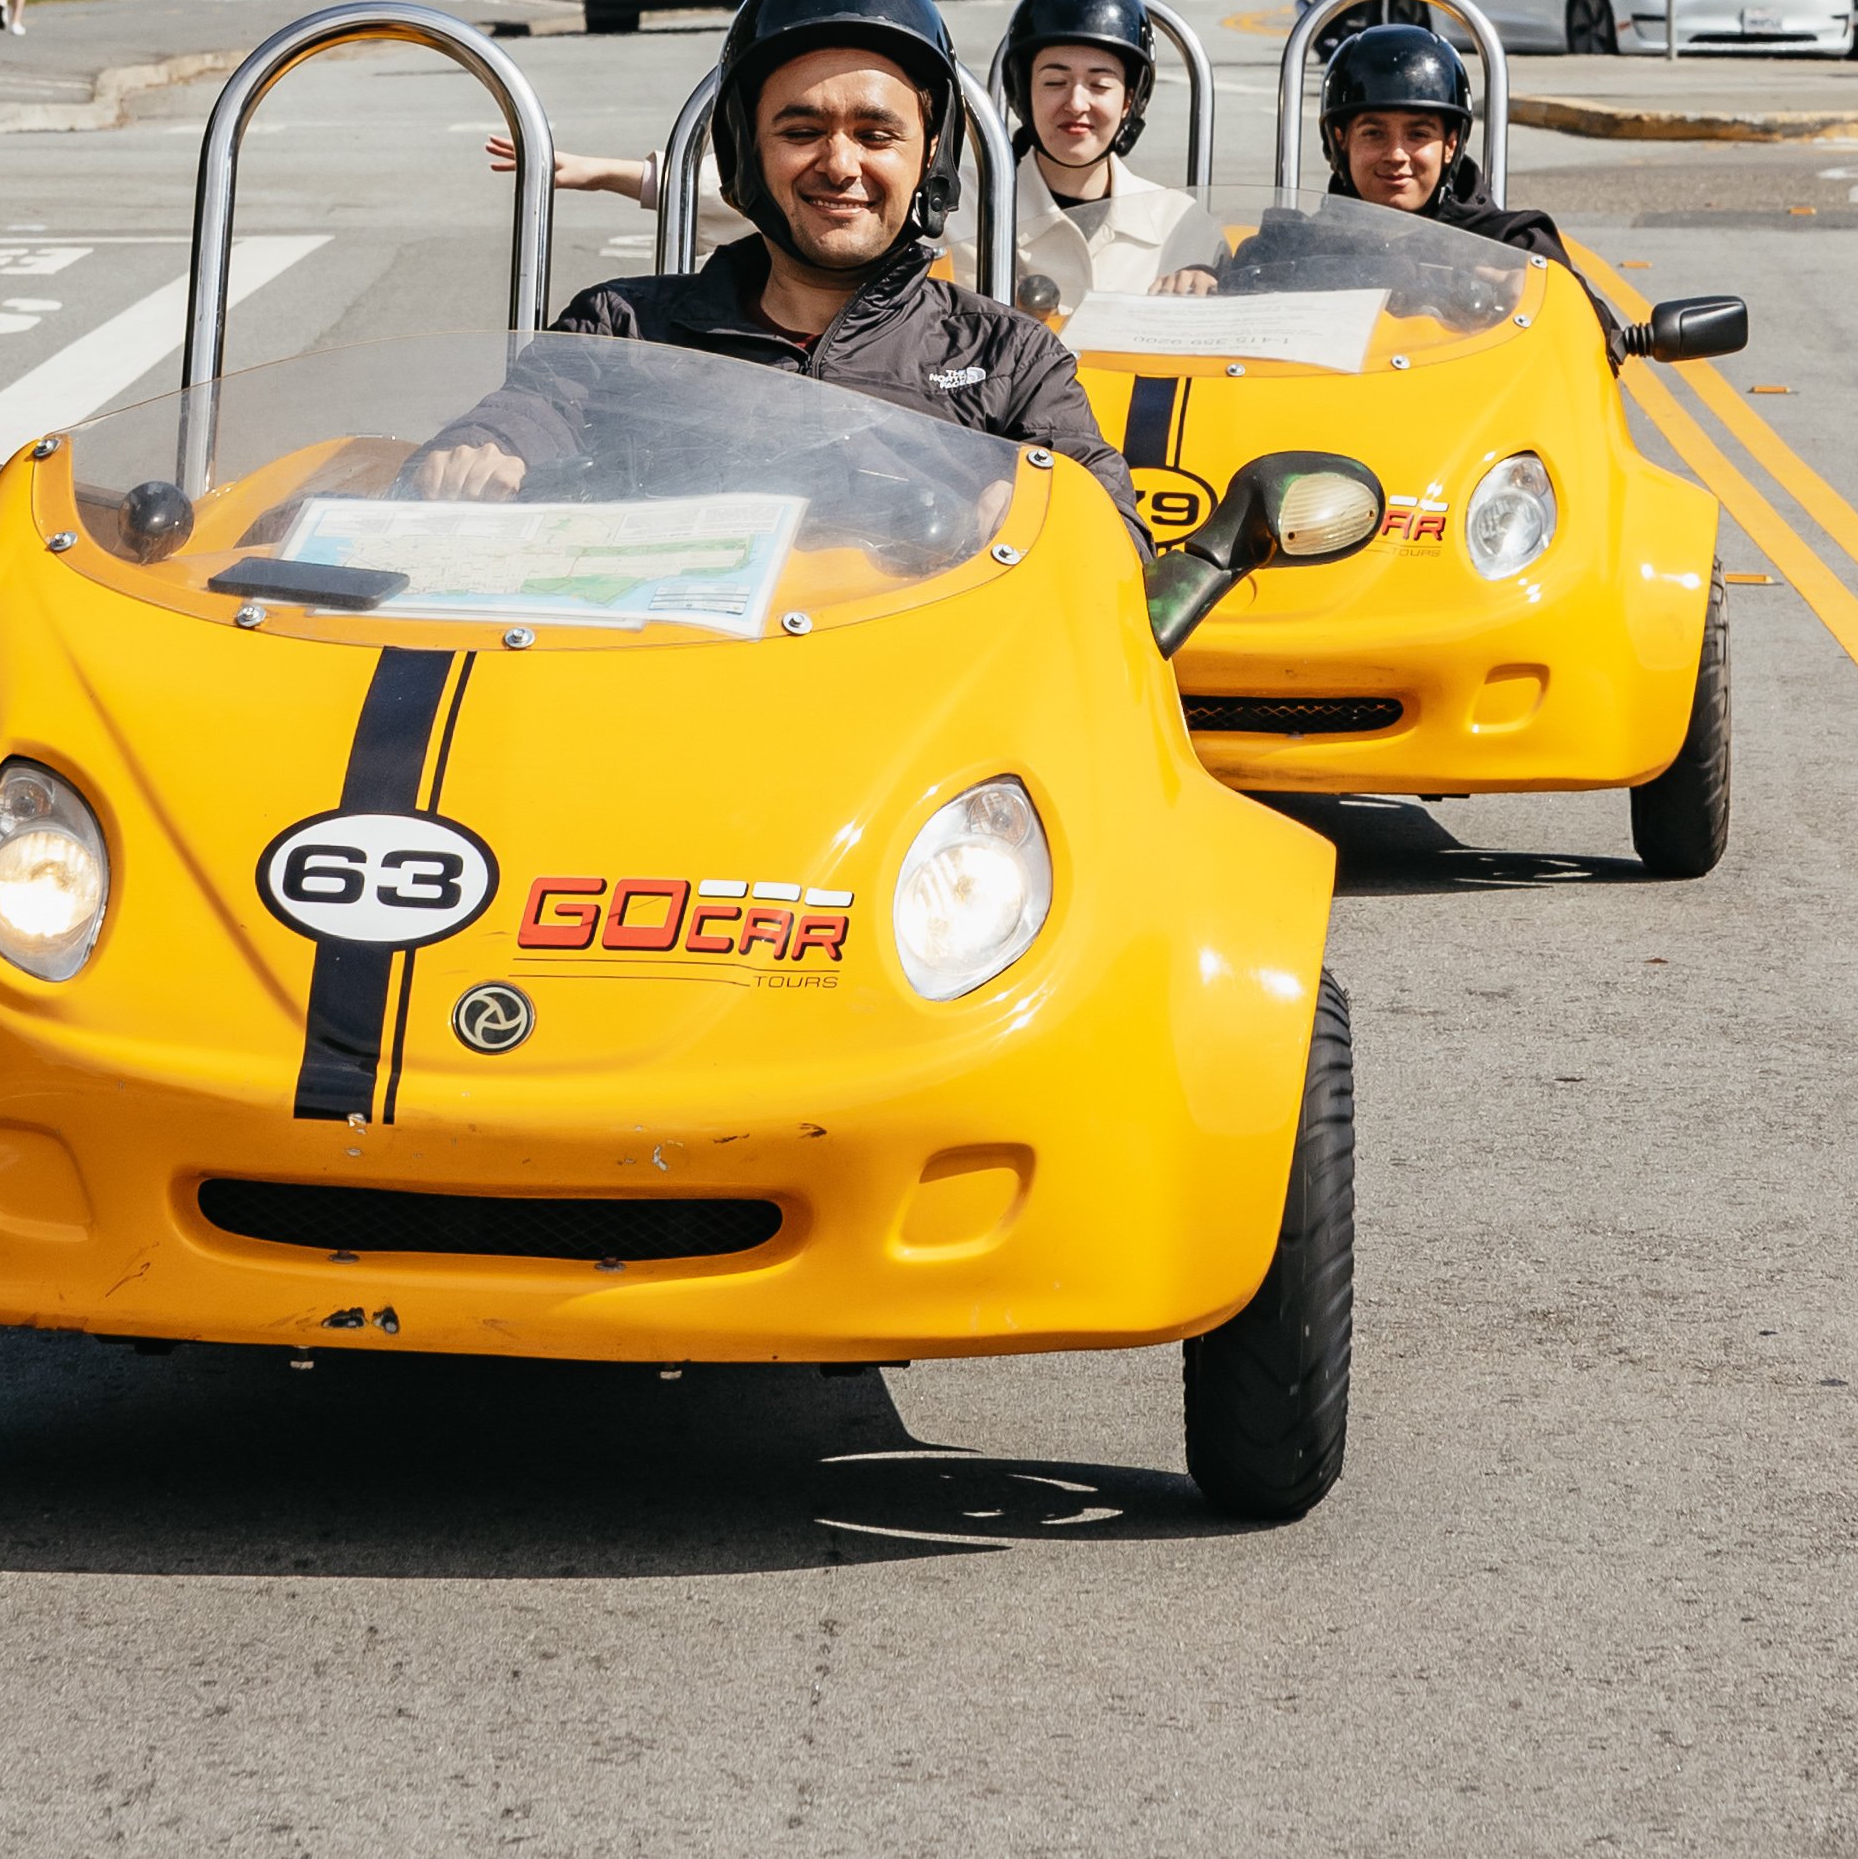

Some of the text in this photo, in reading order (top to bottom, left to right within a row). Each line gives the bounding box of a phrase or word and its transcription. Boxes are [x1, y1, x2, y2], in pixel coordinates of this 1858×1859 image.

[929, 373, 967, 384] NORTH
[945, 369, 966, 381] THE
[940, 380, 966, 389] FACE
[1135, 490, 1200, 527] 9
[1389, 547, 1442, 558] TOURS
[281, 844, 464, 910] 63
[753, 974, 839, 990] TOURS
